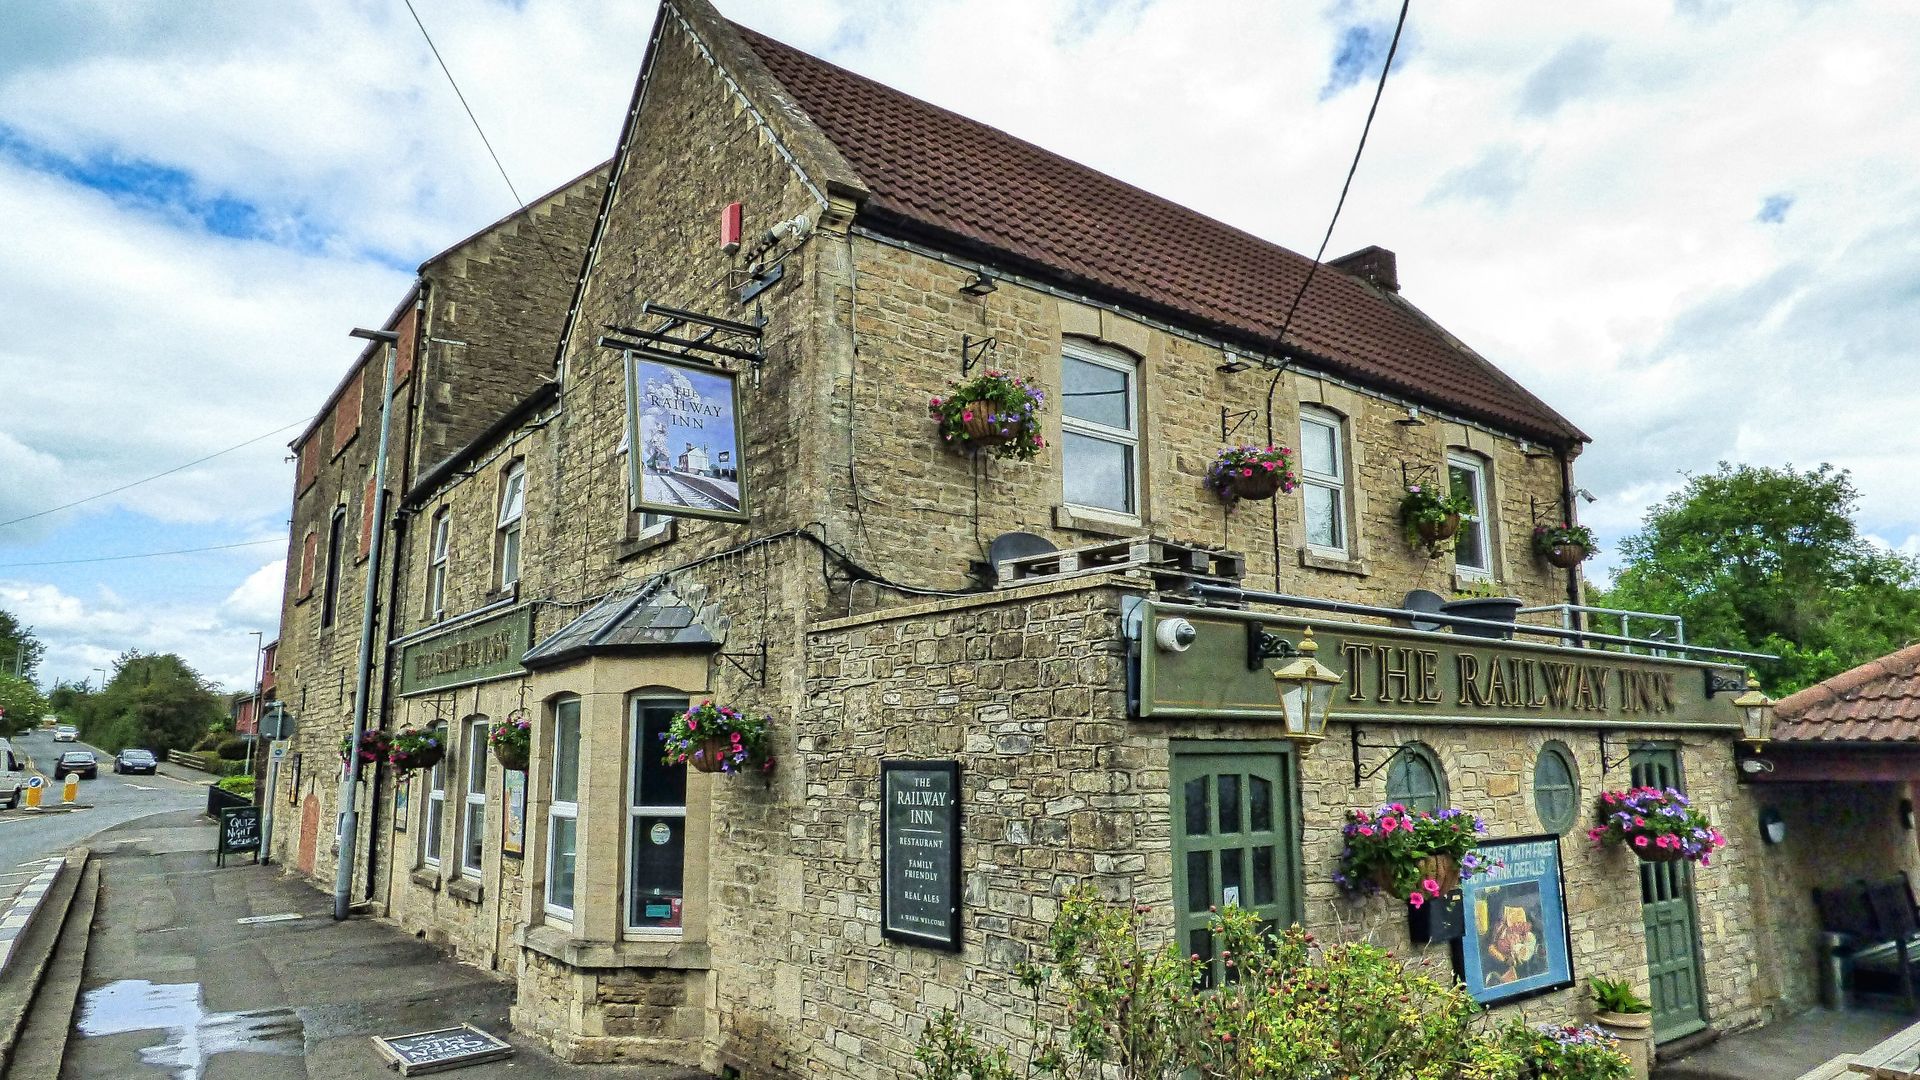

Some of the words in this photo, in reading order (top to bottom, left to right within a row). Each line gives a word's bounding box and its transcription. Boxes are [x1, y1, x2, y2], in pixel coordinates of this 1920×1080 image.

[674, 386, 699, 399] THE
[651, 394, 722, 417] RAILWAY
[672, 414, 704, 430] INN
[1341, 640, 1443, 703] THE
[1457, 652, 1611, 712] RAILWAY
[1618, 667, 1676, 716] INN
[914, 777, 931, 789] THE
[897, 790, 946, 807] RAILWAY
[230, 817, 256, 828] QUIZ
[910, 808, 933, 825] INN
[227, 826, 254, 838] NIGHT
[899, 836, 944, 849] RESTAURANT
[908, 859, 934, 870] FAMILY
[904, 869, 938, 882] FRIENDLY
[904, 890, 921, 902] REAL
[923, 892, 940, 904] ALES
[920, 916, 945, 927] WELCOME
